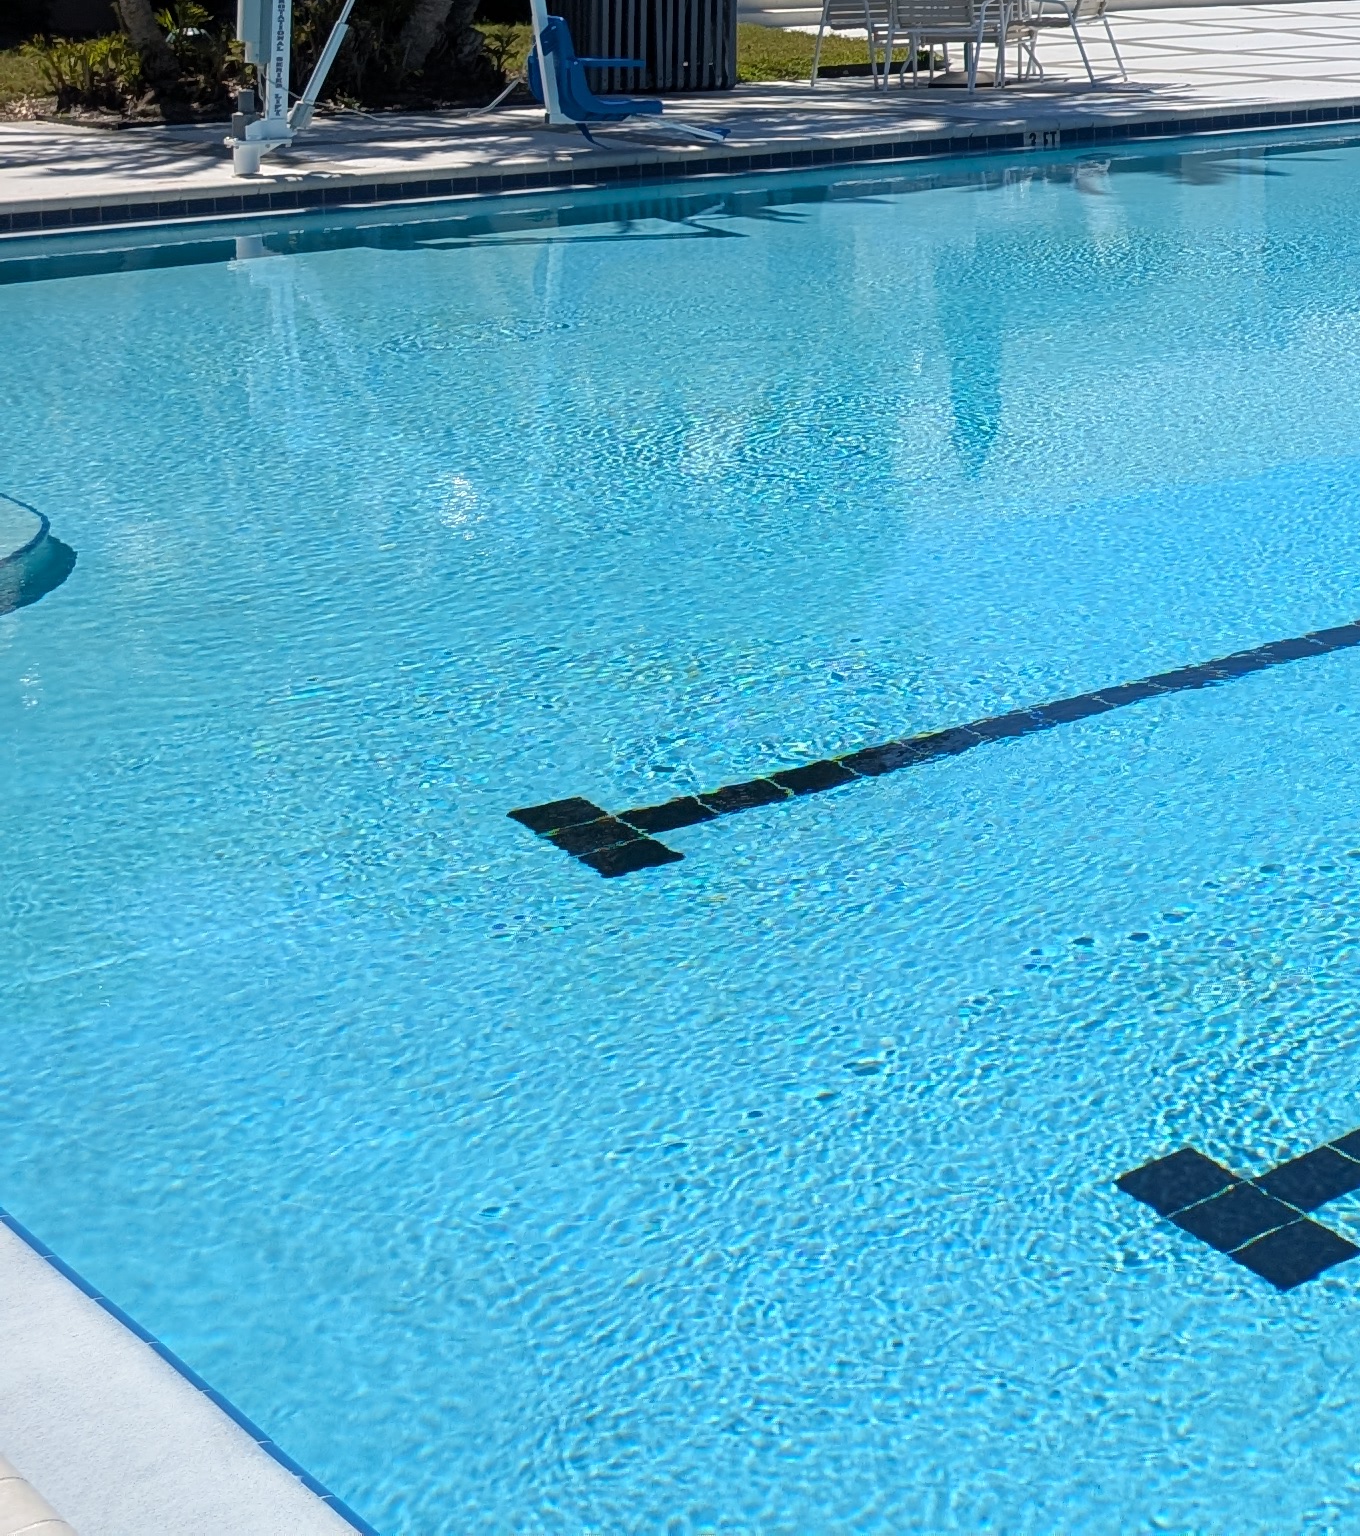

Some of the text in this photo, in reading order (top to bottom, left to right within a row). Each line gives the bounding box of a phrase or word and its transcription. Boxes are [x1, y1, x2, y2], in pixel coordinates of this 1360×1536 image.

[275, 57, 283, 88] SERIES
[274, 94, 282, 116] LIFT
[1043, 131, 1057, 147] FT
